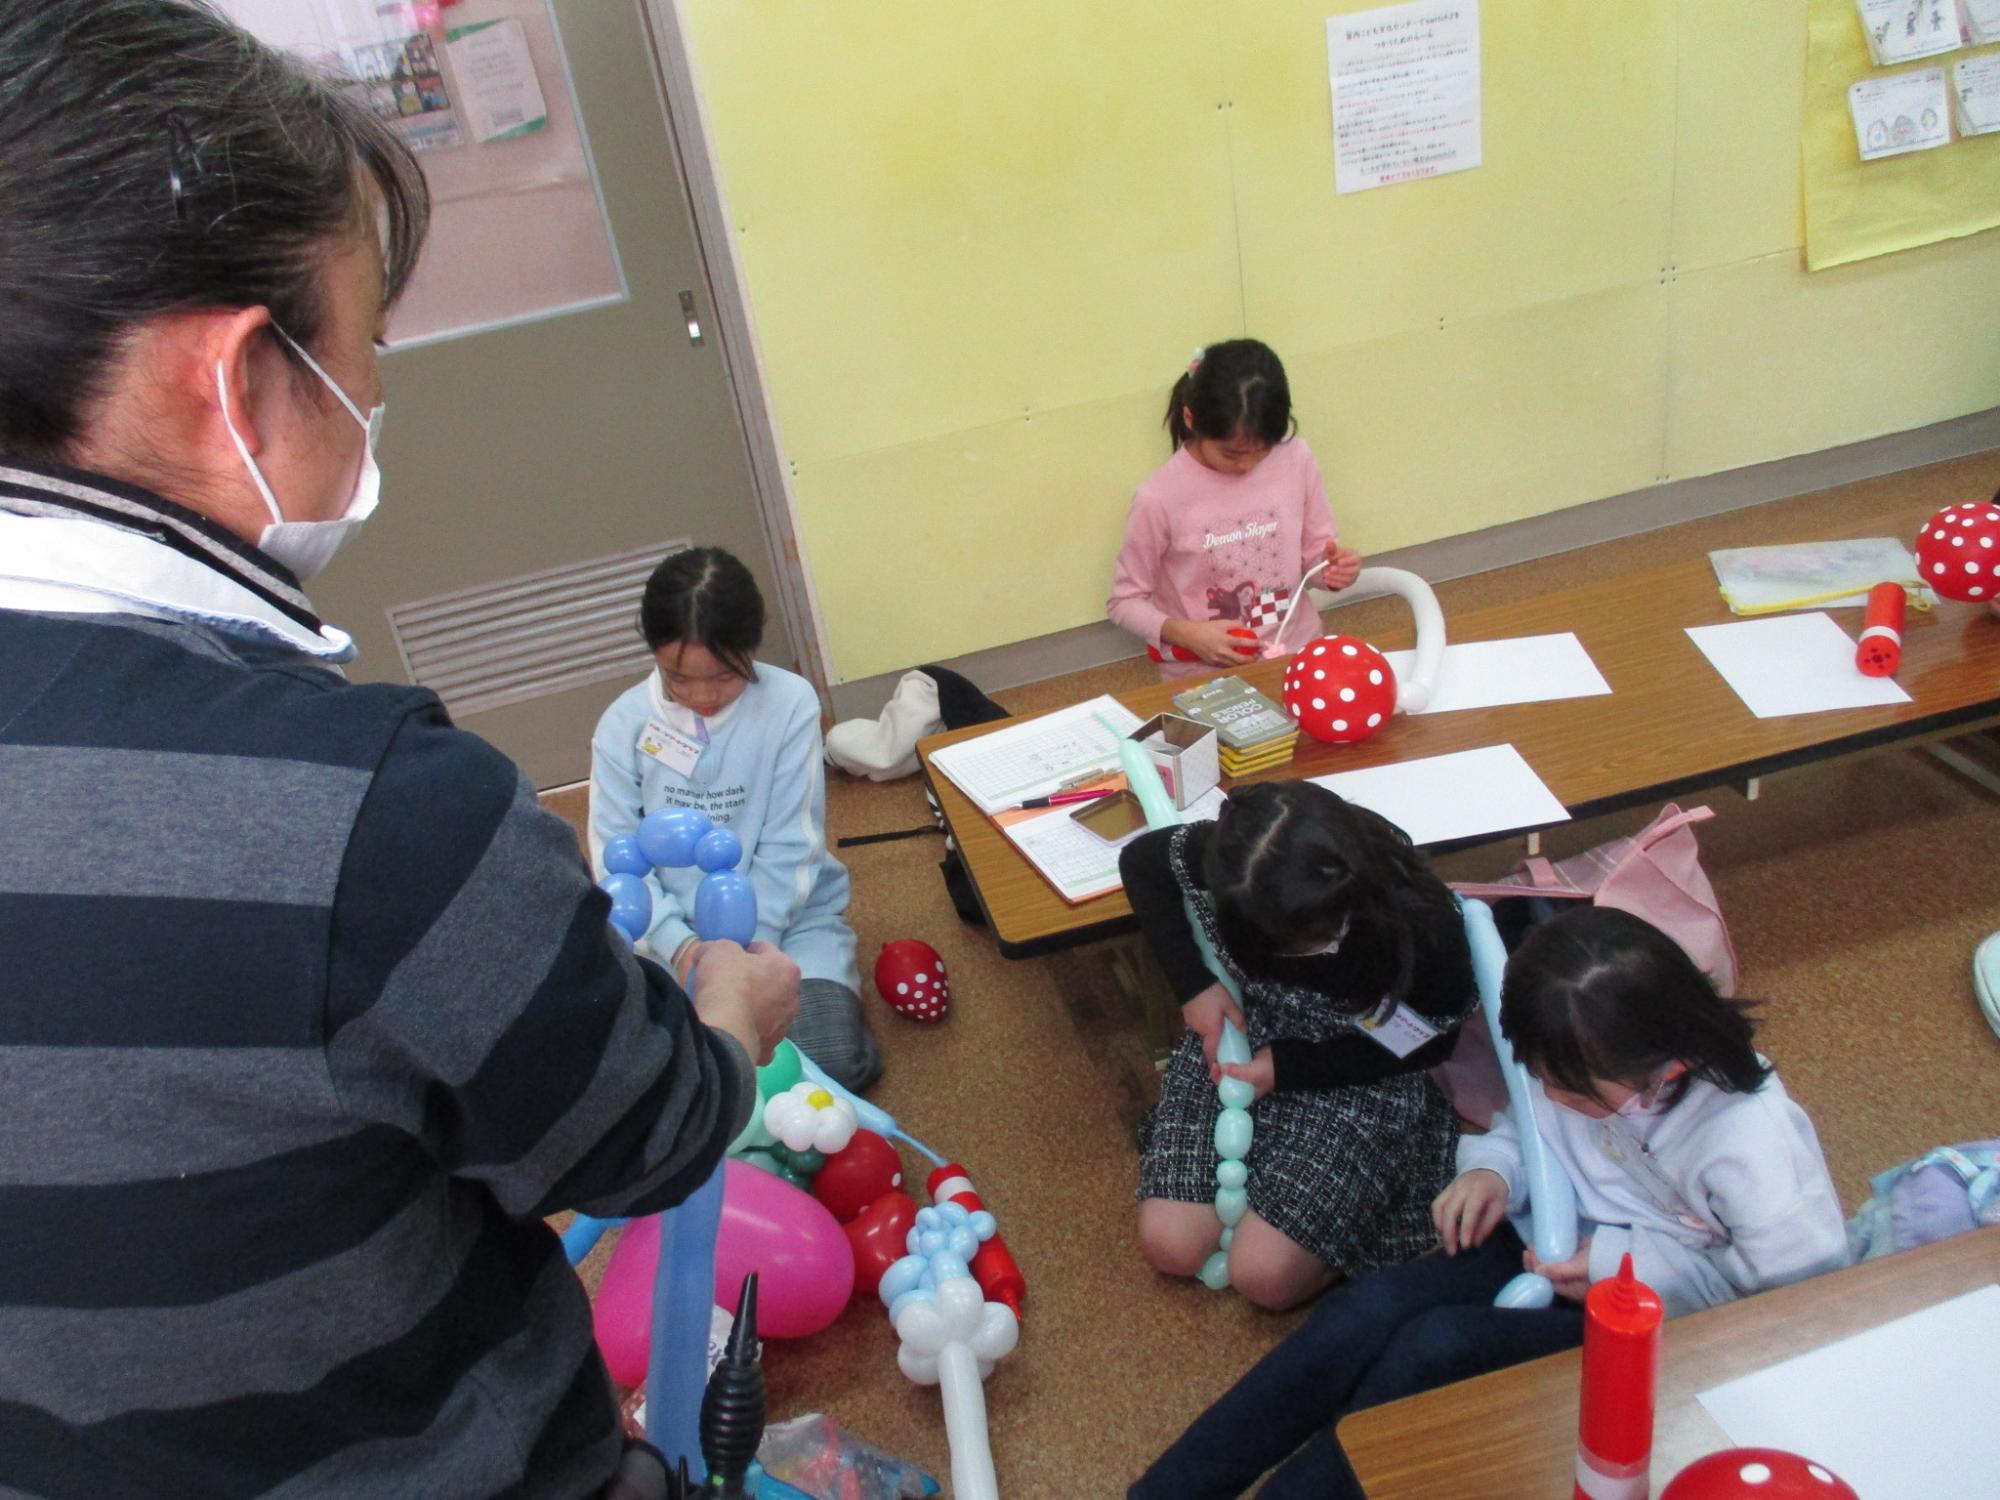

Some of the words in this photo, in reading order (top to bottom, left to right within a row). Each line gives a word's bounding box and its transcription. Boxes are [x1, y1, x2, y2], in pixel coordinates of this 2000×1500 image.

[1203, 530, 1243, 549] Demon
[1245, 521, 1278, 540] Slayer
[1211, 698, 1257, 719] PENCILS
[1217, 703, 1264, 724] COLOR
[664, 785, 676, 793] no
[706, 790, 724, 800] how
[725, 785, 745, 797] dark
[710, 802, 724, 812] the
